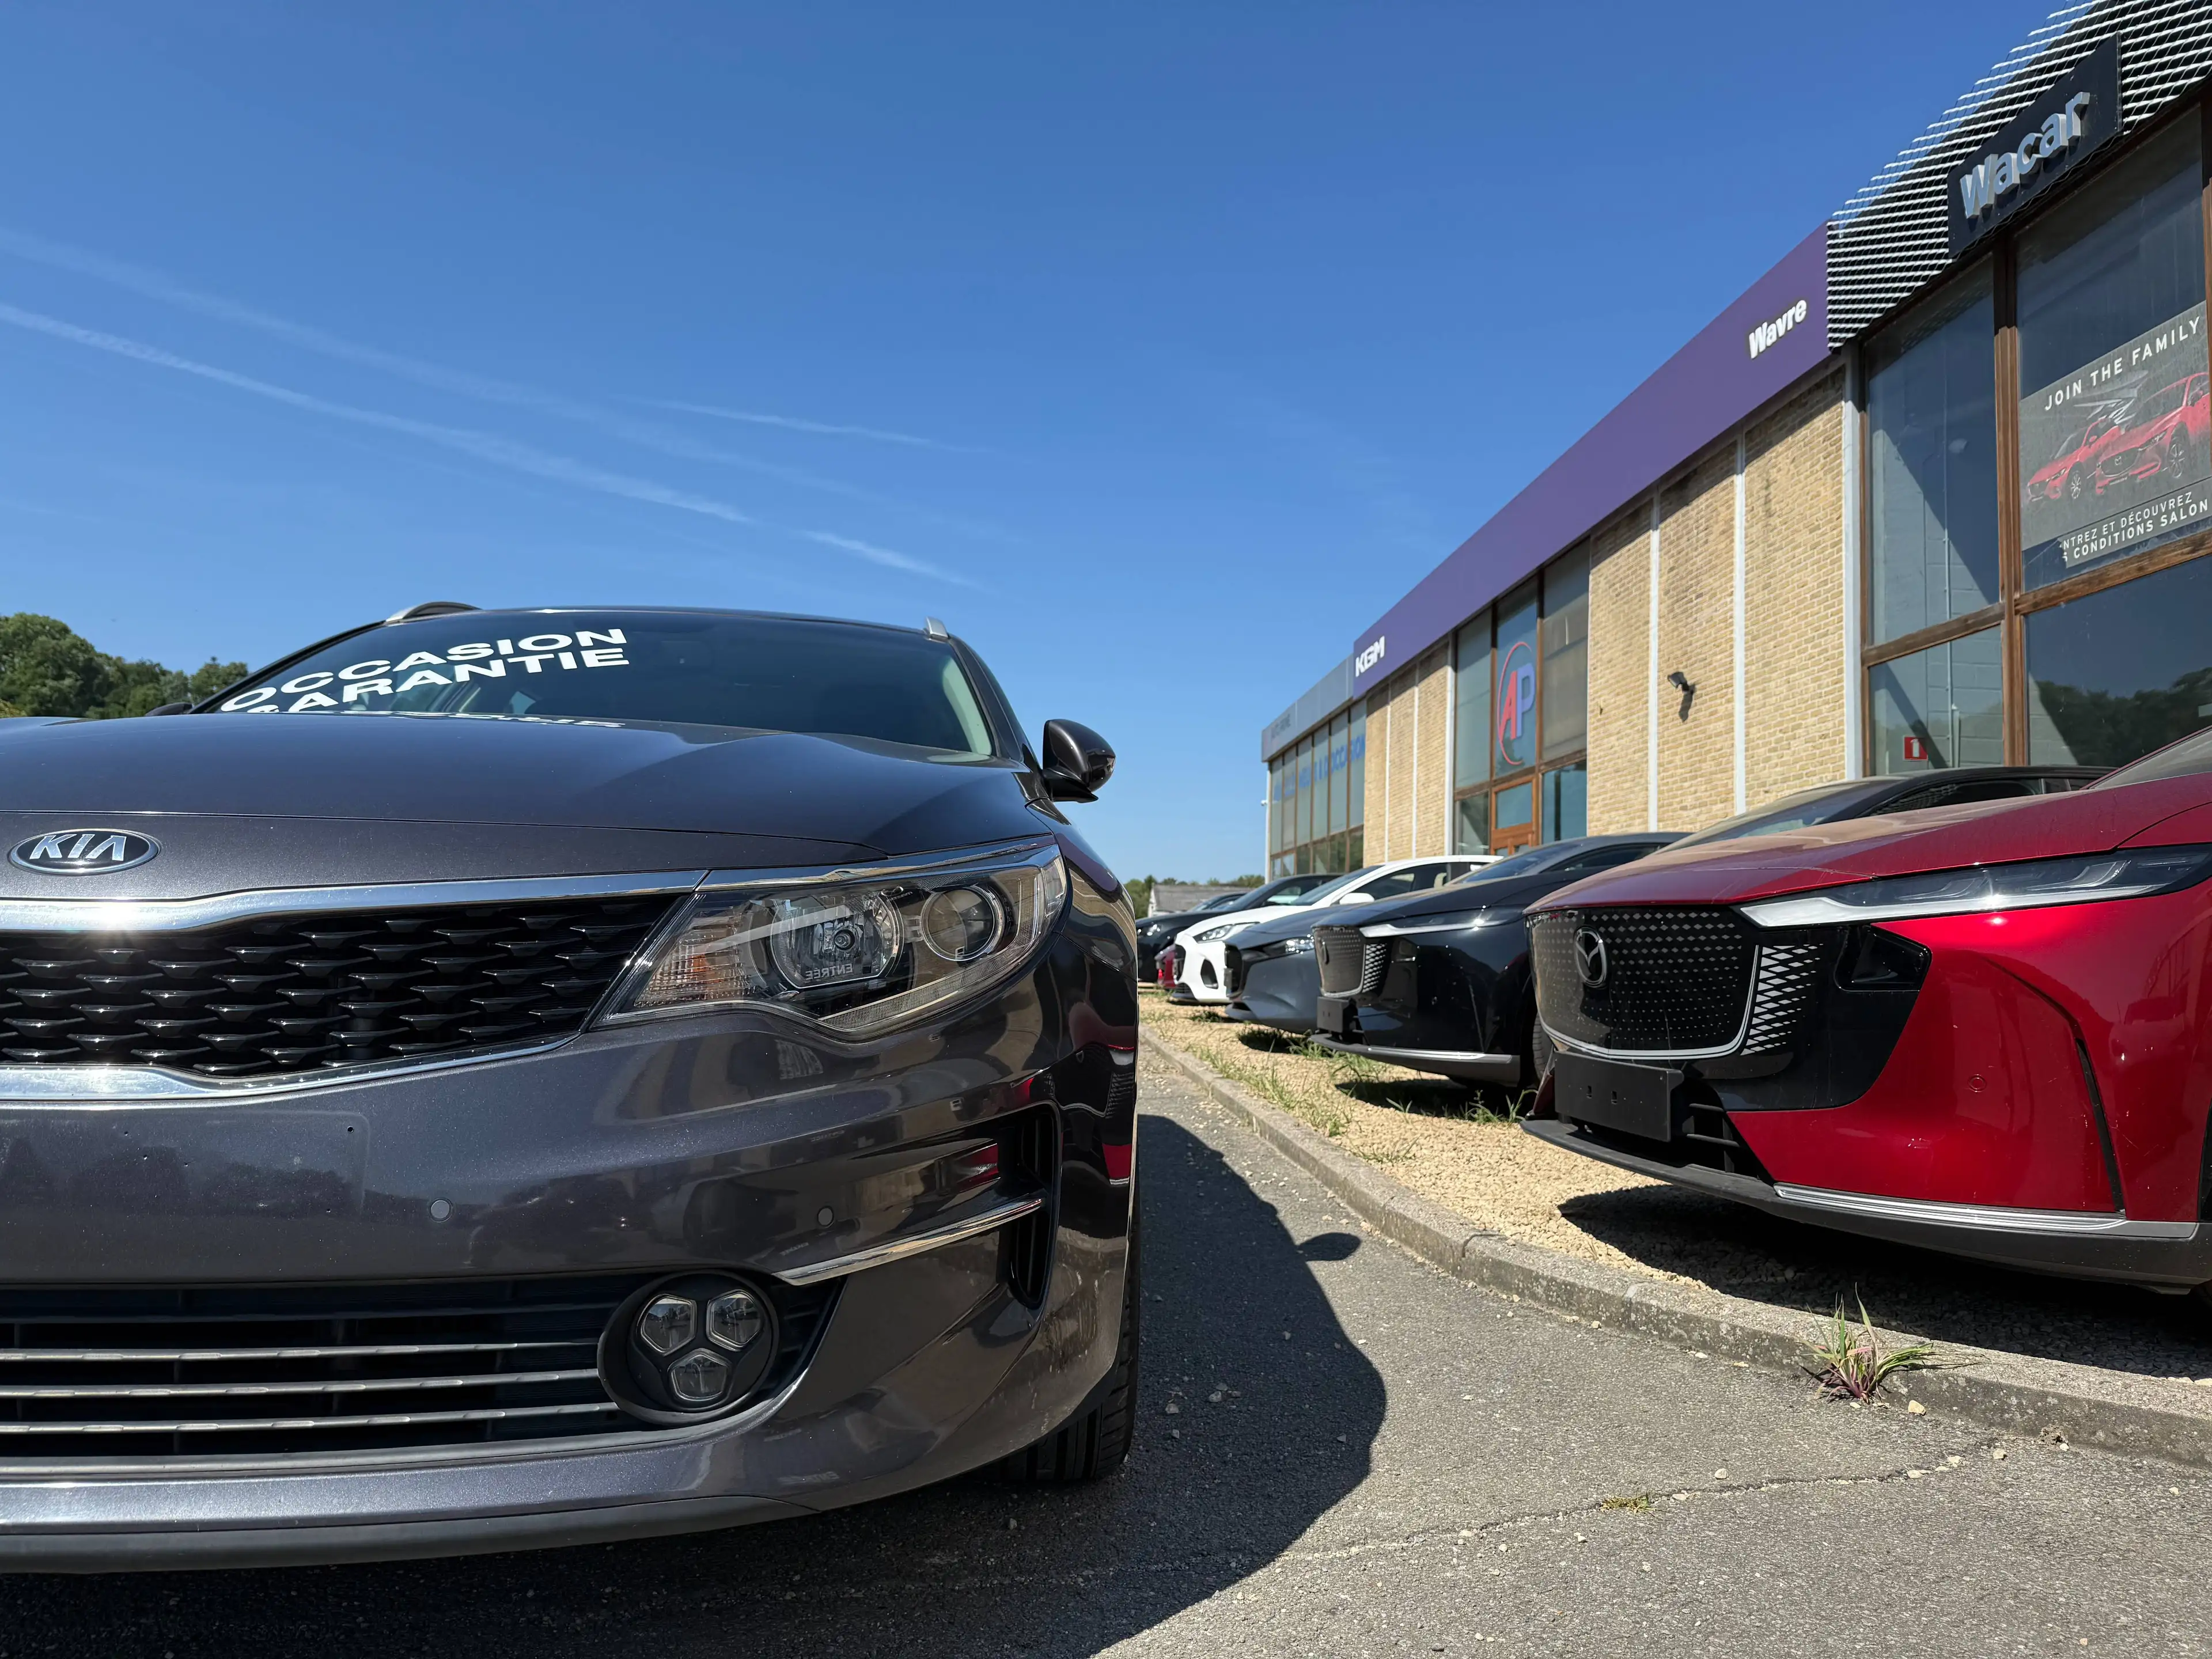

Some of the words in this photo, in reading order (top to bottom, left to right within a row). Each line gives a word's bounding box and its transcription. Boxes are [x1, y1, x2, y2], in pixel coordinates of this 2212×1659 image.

[1960, 92, 2090, 219] Wacar
[1749, 300, 1807, 359] Wavre
[2045, 379, 2082, 411] JOIN
[2090, 357, 2123, 387] THE
[2132, 316, 2200, 366] FAMILY
[2060, 528, 2097, 550] NTREZ
[2103, 521, 2115, 535] ET
[2121, 491, 2192, 529] DÉCOUVREZ
[2074, 520, 2153, 559] CONDITIONS
[2160, 499, 2208, 527] SALON
[221, 628, 627, 712] OCCASION
[1355, 635, 1385, 677] KGM
[29, 834, 127, 861] KIA
